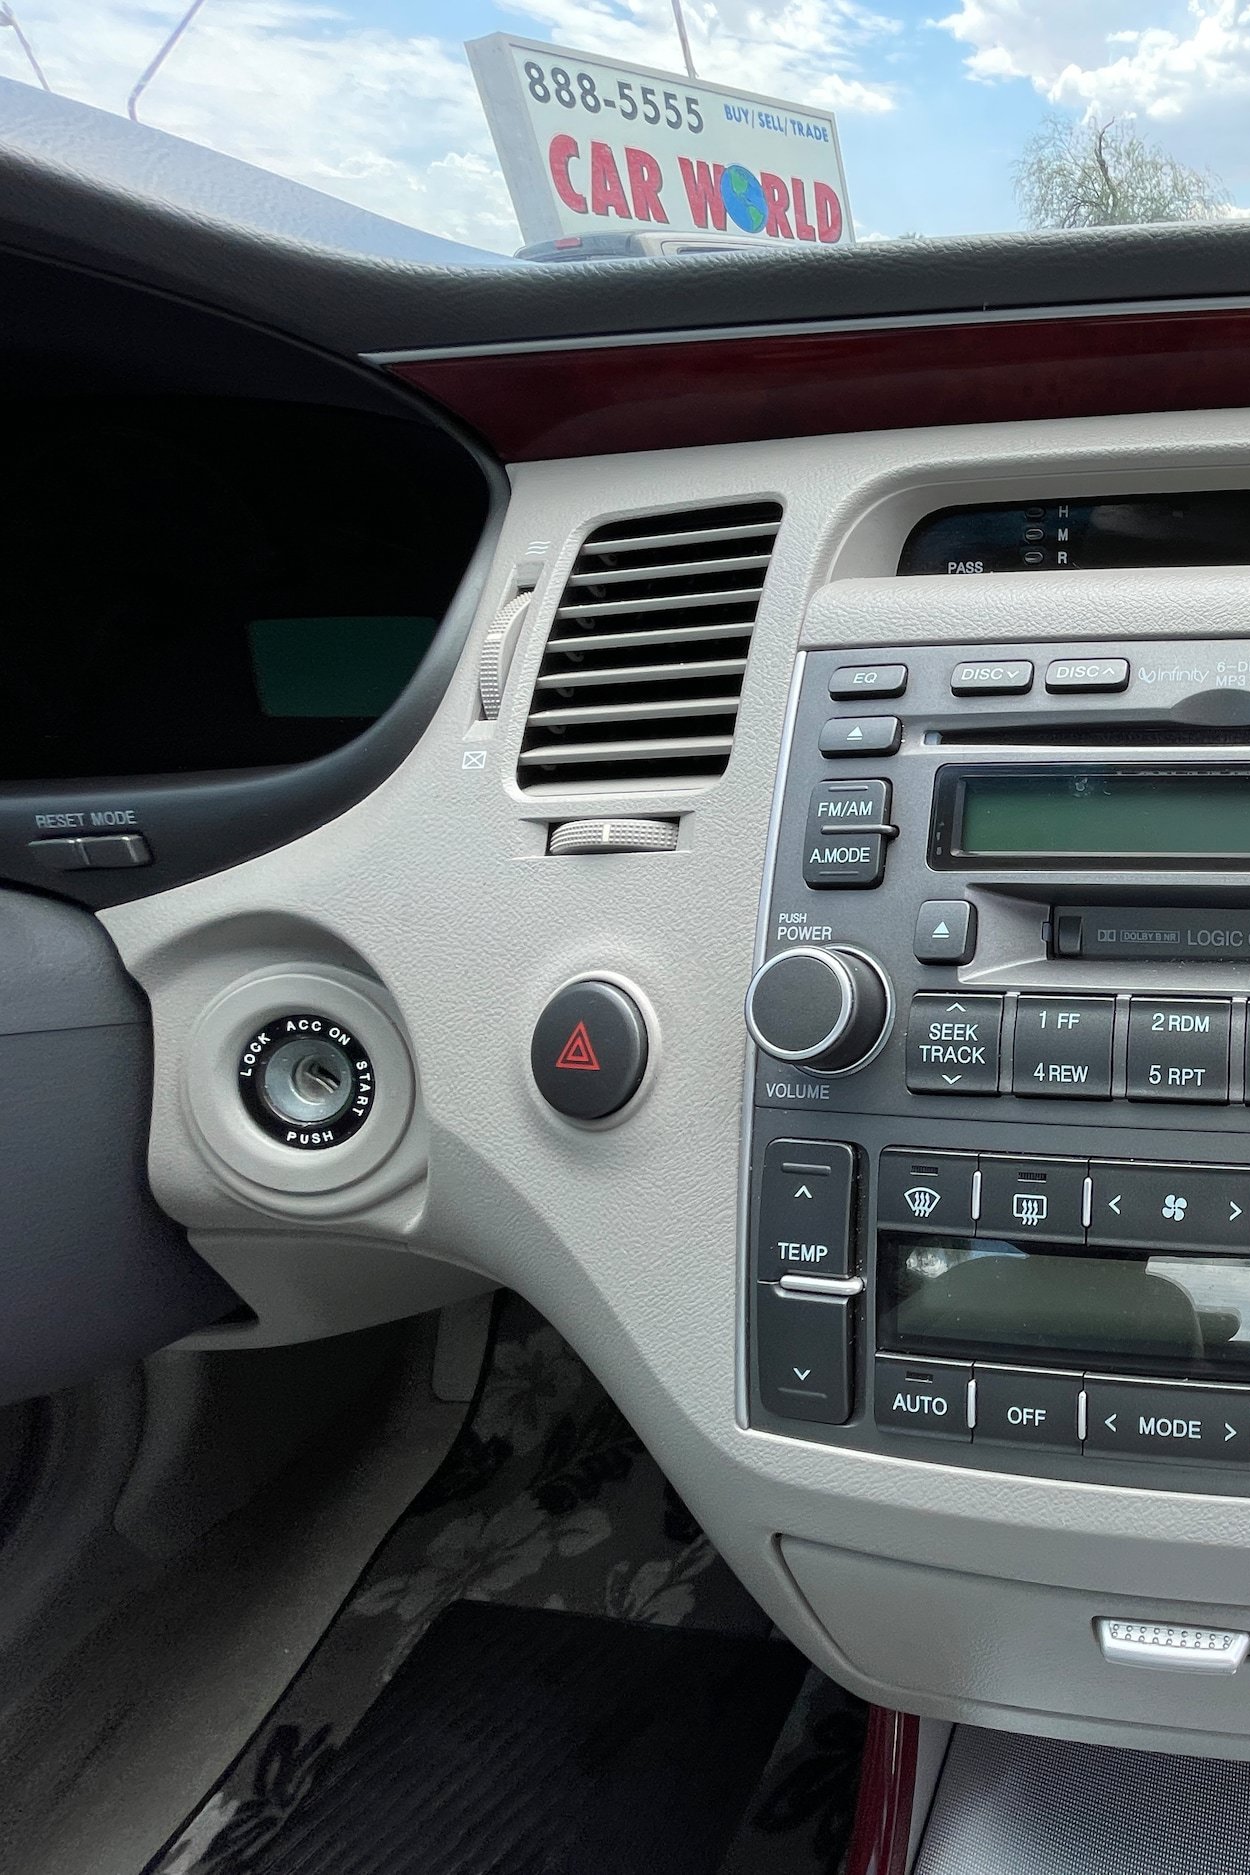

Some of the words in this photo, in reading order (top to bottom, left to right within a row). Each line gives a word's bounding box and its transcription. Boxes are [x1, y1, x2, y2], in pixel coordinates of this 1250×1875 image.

[523, 60, 704, 134] 888-5555
[549, 133, 669, 225] CAR
[1058, 504, 1069, 518] H
[1057, 528, 1069, 541] M
[1057, 551, 1068, 564] R
[947, 560, 984, 574] PASS
[852, 672, 878, 685] EQ
[961, 667, 1004, 681] DISC
[1056, 665, 1100, 678] DISC
[1216, 675, 1246, 687] MP3
[818, 801, 873, 817] FM/AM
[35, 813, 85, 829] RESET
[90, 810, 138, 826] MODE
[810, 848, 870, 864] A.MODE
[778, 913, 808, 924] PUSH
[777, 926, 832, 940] POWER
[1124, 932, 1153, 941] DOLBY
[1187, 930, 1243, 947] LOGIC
[286, 1019, 322, 1032] ACC
[1039, 1011, 1047, 1029] 1
[1057, 1013, 1080, 1029] FF
[1152, 1013, 1164, 1031] 2
[1168, 1015, 1210, 1032] RDM
[329, 1027, 351, 1046] ON
[929, 1023, 978, 1041] SEEK
[240, 1032, 271, 1077] LOCK
[919, 1045, 985, 1064] TRACK
[1034, 1063, 1046, 1081] 4
[1049, 1065, 1088, 1083] REW
[1149, 1065, 1161, 1085] 5
[1168, 1068, 1205, 1086] RPT
[352, 1060, 371, 1116] START
[766, 1083, 830, 1099] VOLUME
[286, 1130, 334, 1145] PUSH
[777, 1242, 828, 1262] TEMP
[892, 1393, 948, 1416] AUTO
[1007, 1406, 1046, 1427] OFF
[1139, 1417, 1201, 1439] MODE
